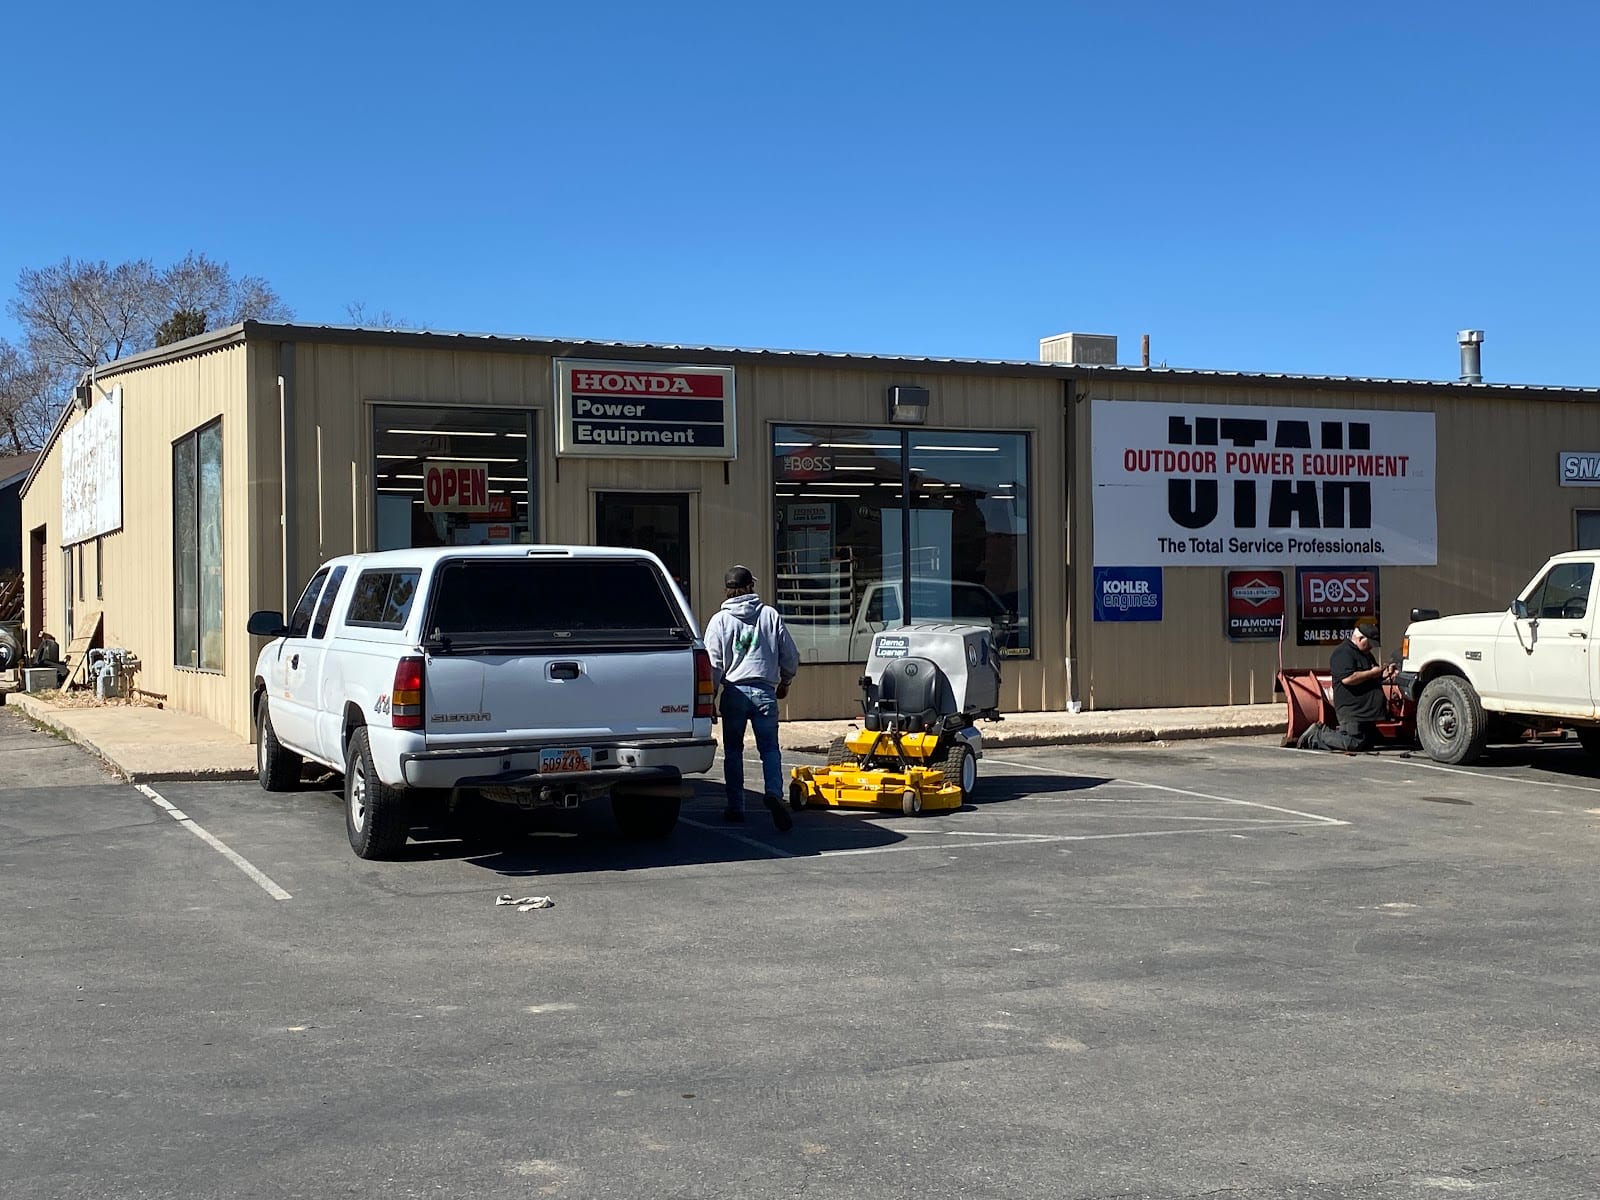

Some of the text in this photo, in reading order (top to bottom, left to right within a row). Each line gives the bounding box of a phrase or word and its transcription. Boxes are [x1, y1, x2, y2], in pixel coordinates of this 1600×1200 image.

[577, 373, 693, 393] HONDA
[577, 400, 645, 417] Power
[577, 424, 694, 445] Equipment
[791, 456, 832, 471] BOSS
[1124, 448, 1409, 477] OUTDOOR POWER EQUIPMENT
[1168, 416, 1371, 529] UTAH
[427, 467, 486, 506] OPEN
[1158, 538, 1385, 554] The Total Service Professionals.
[1103, 580, 1149, 594] KOHLER
[1309, 578, 1369, 602] BOSS
[1103, 593, 1157, 611] engines
[1231, 618, 1282, 627] DIAMOND
[1303, 629, 1331, 641] SALES
[1331, 629, 1338, 641] &
[431, 712, 492, 723] SIERRA
[660, 705, 689, 713] GMC
